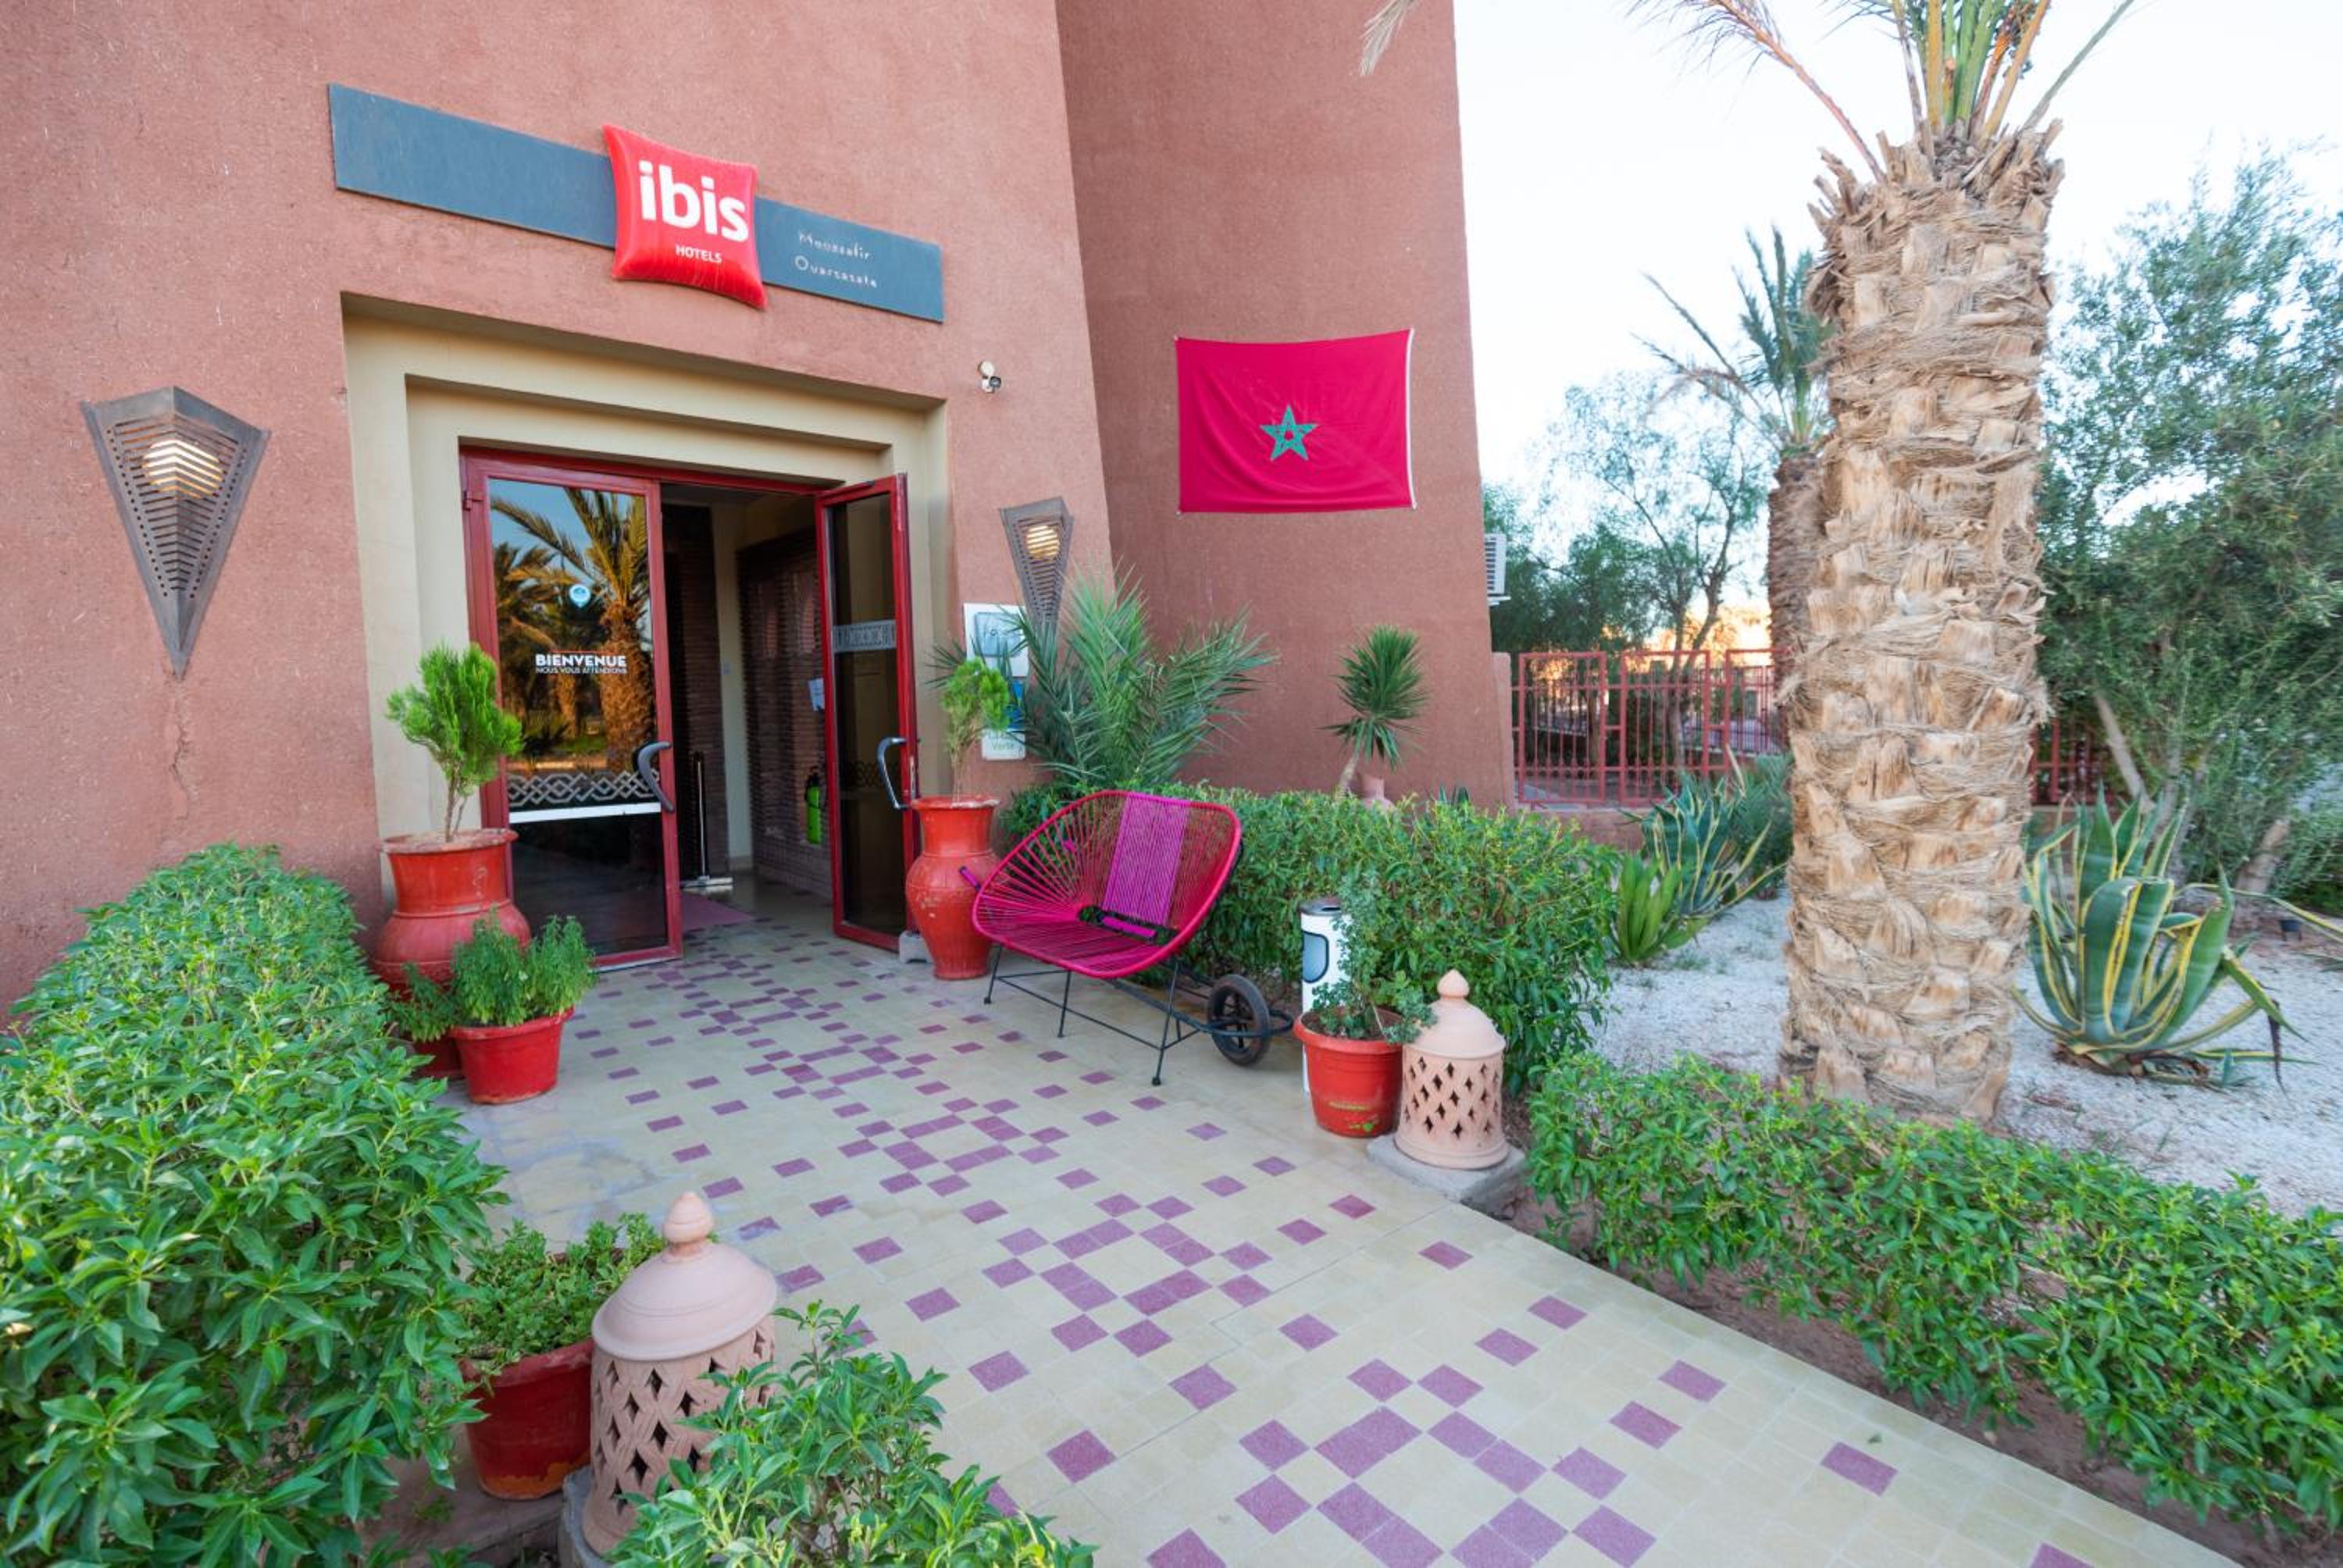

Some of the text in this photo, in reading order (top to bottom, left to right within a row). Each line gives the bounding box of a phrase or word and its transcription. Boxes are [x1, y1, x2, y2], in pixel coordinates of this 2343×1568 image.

[639, 159, 749, 243] ibis
[676, 244, 722, 263] HOTELS
[535, 654, 626, 667] BIENVENUE
